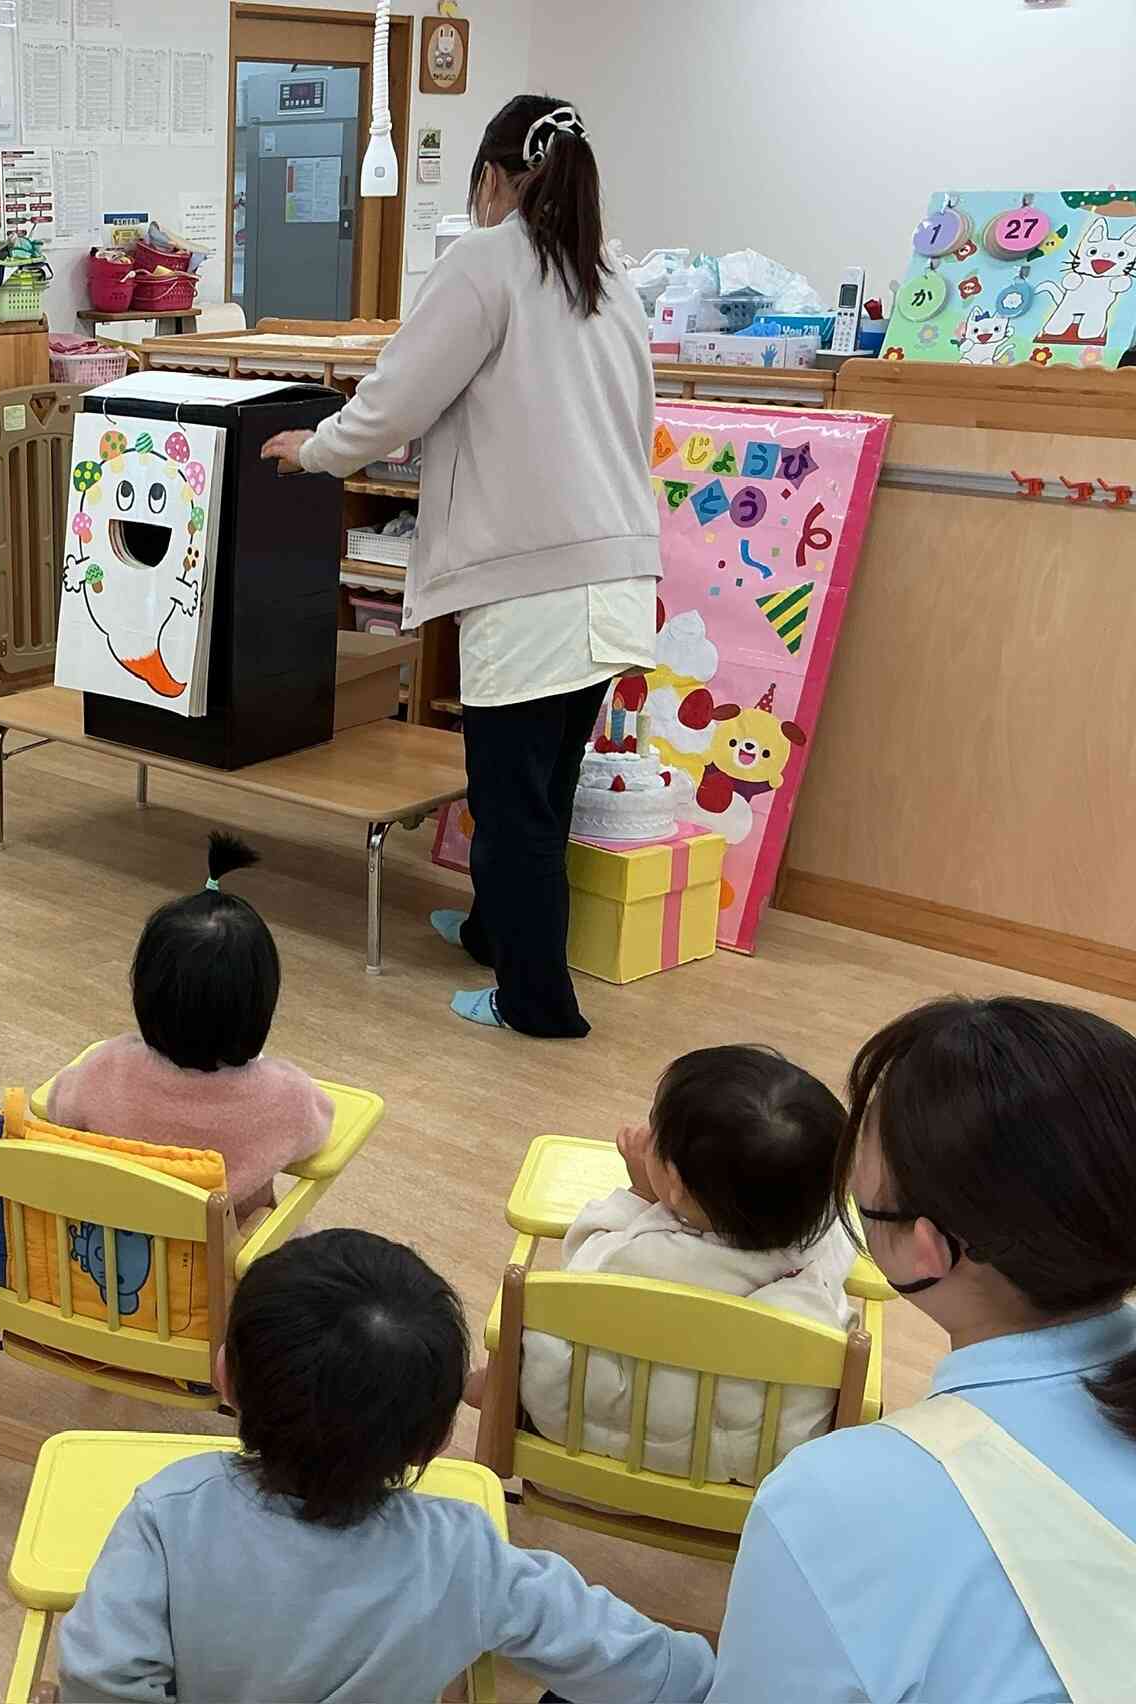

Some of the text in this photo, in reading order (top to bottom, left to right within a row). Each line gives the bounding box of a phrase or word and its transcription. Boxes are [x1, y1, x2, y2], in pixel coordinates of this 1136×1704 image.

[929, 223, 942, 245] 1
[1004, 218, 1039, 240] 27
[911, 288, 933, 307] か
